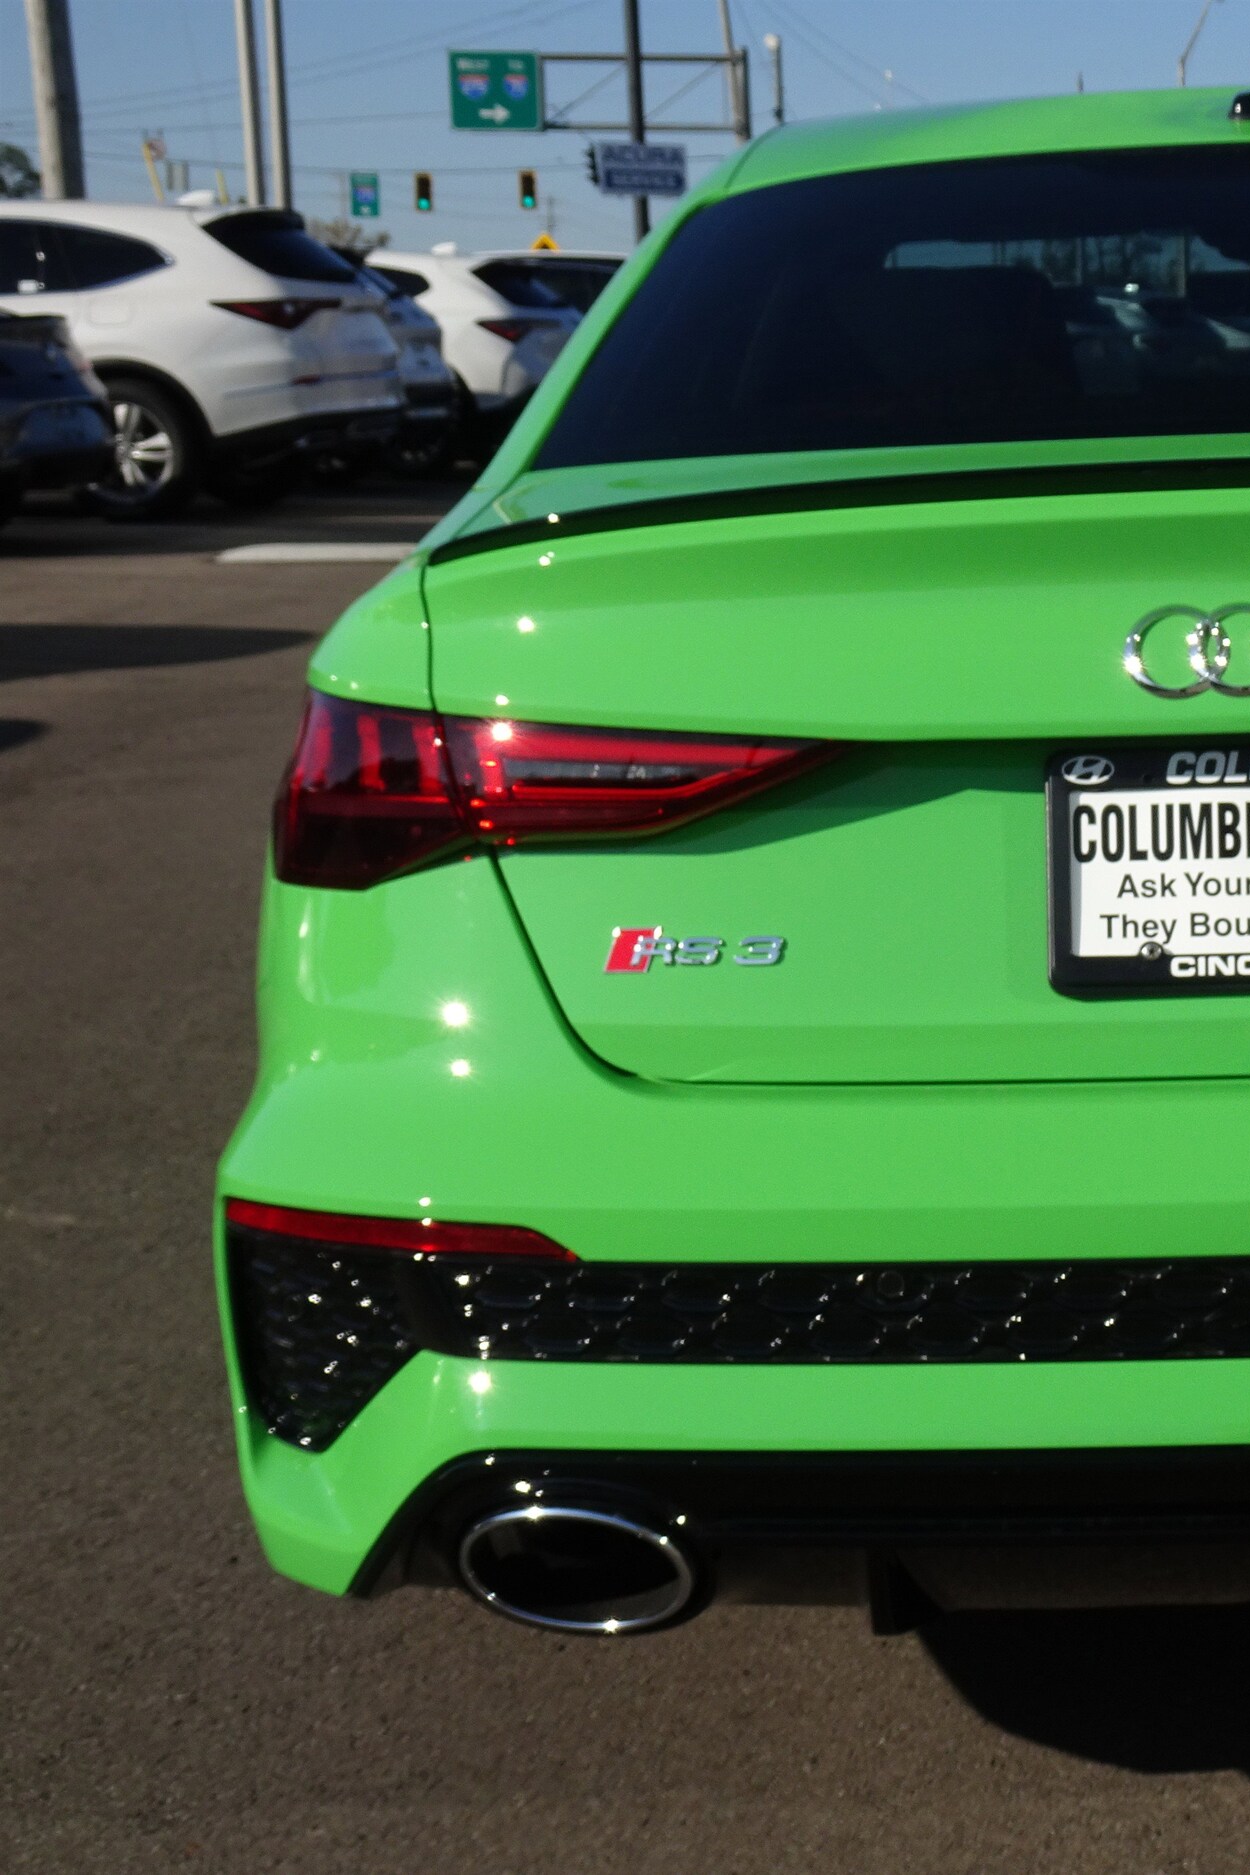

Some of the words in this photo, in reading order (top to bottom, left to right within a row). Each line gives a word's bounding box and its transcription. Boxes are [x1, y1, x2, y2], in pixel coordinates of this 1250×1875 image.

[1116, 872, 1177, 899] Ask
[1099, 913, 1177, 945] They
[629, 935, 723, 966] RS
[732, 935, 786, 966] 3
